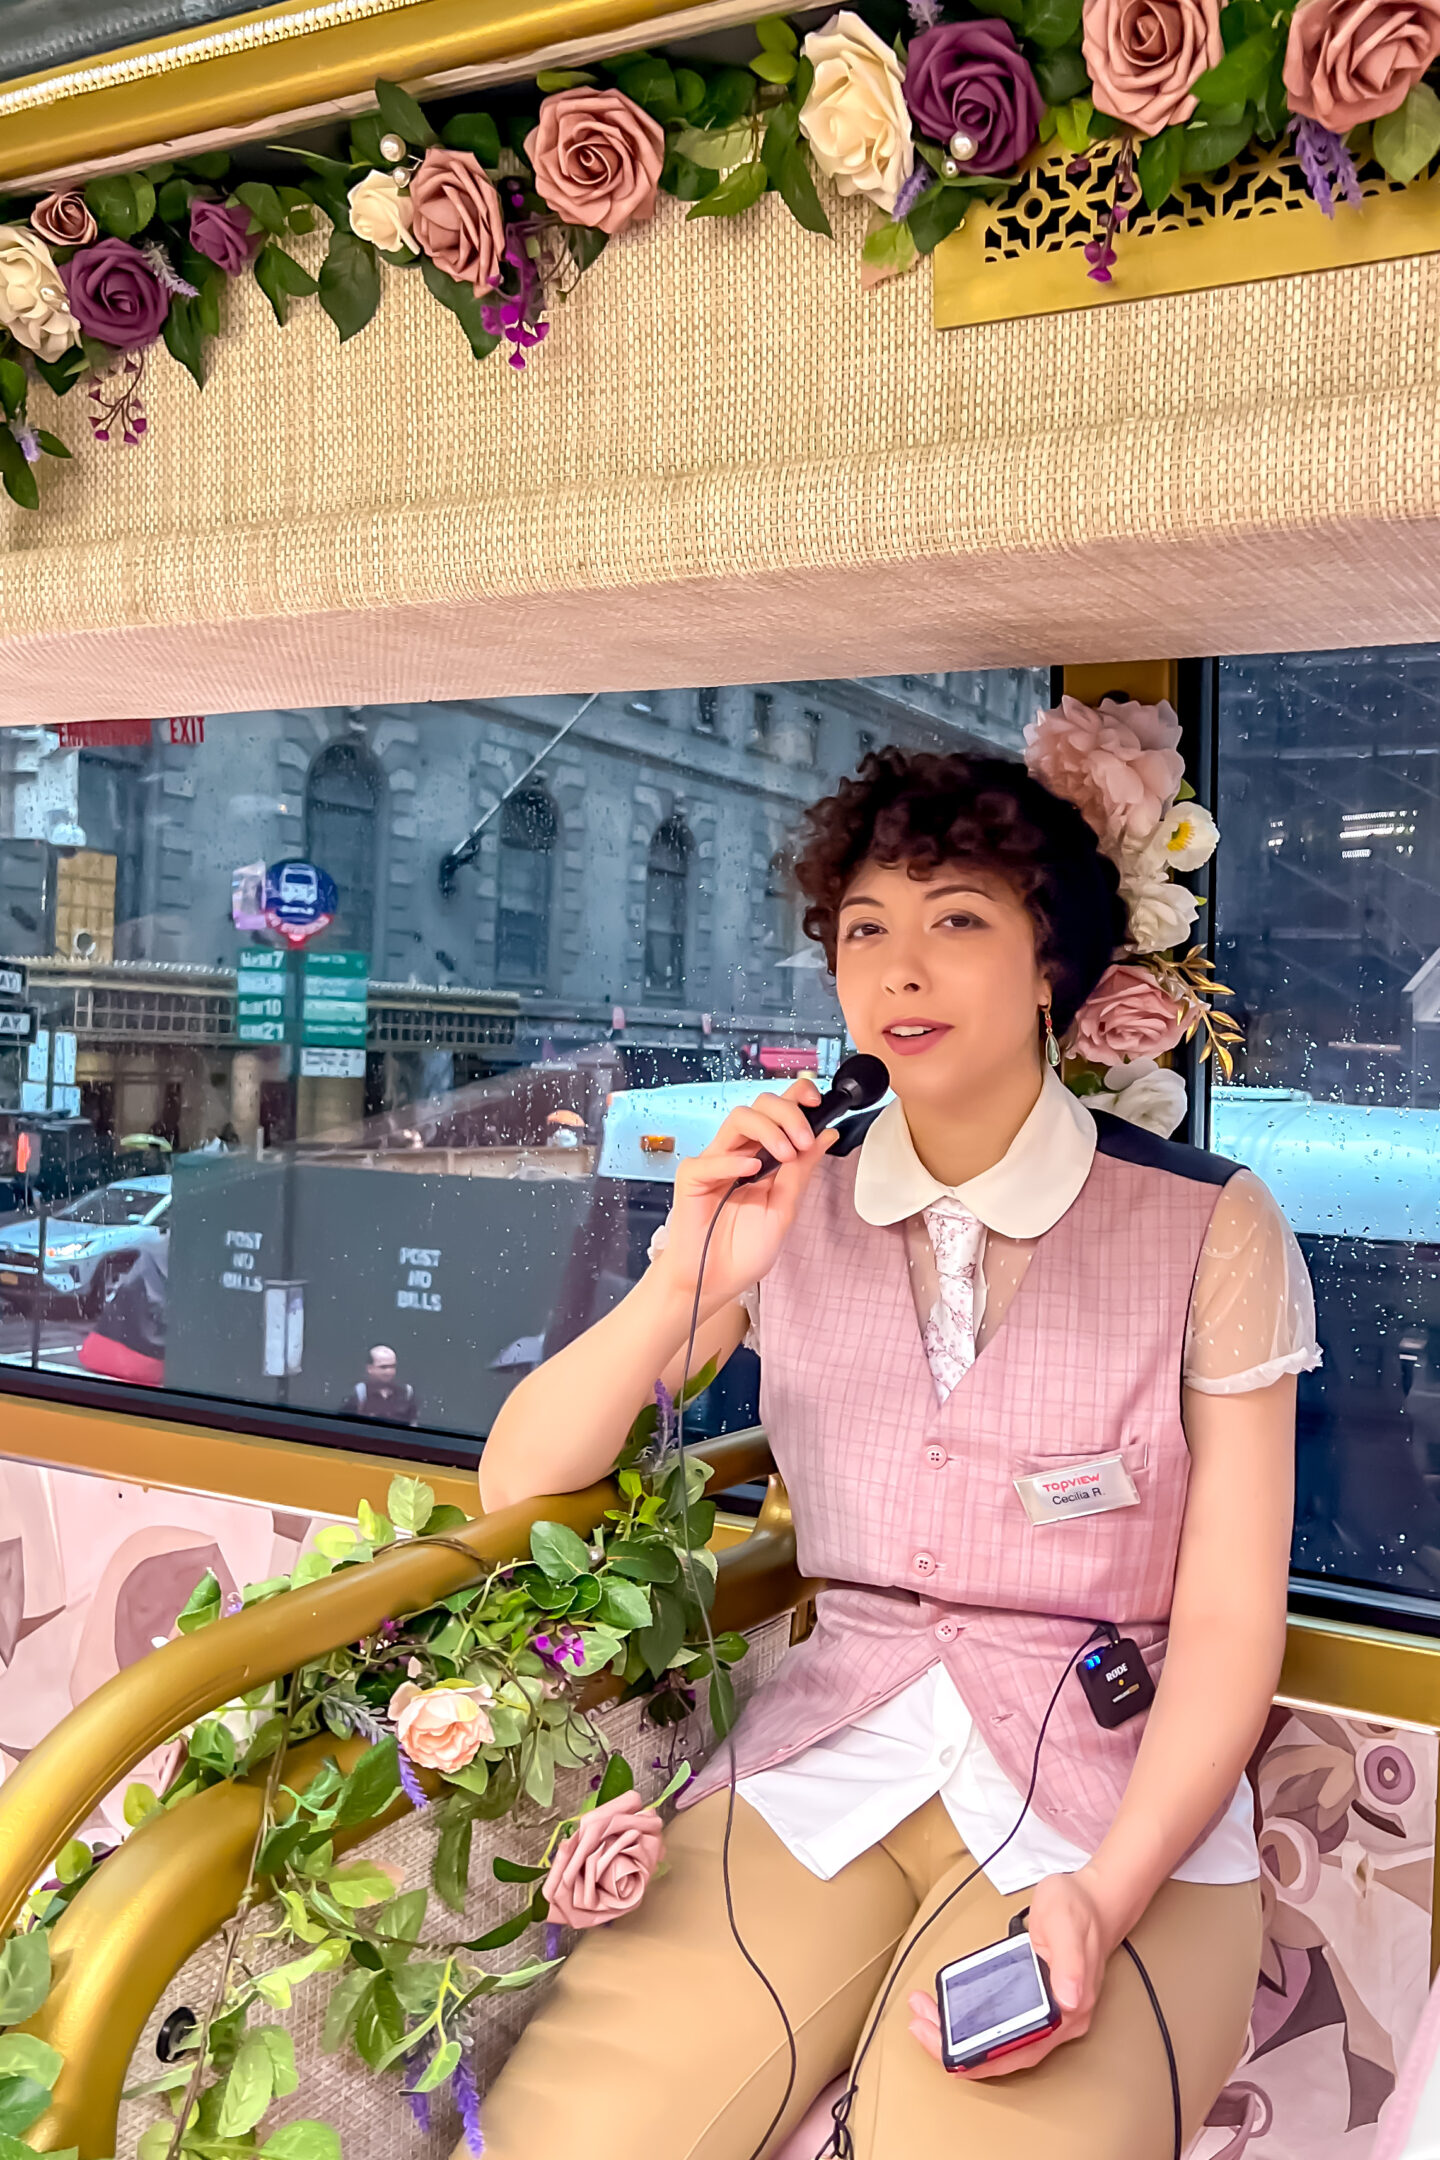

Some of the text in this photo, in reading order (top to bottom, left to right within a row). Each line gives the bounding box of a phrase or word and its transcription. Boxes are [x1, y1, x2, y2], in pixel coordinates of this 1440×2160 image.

[170, 717, 205, 744] EXIT
[0, 973, 16, 988] AY
[0, 1015, 21, 1030] AY
[226, 1230, 263, 1249] POST
[233, 1252, 254, 1269] NO
[400, 1247, 442, 1267] POST
[222, 1271, 263, 1292] BILLS
[407, 1270, 432, 1288] NO
[397, 1290, 442, 1312] BILLS
[1052, 1490, 1090, 1505] Cecilia
